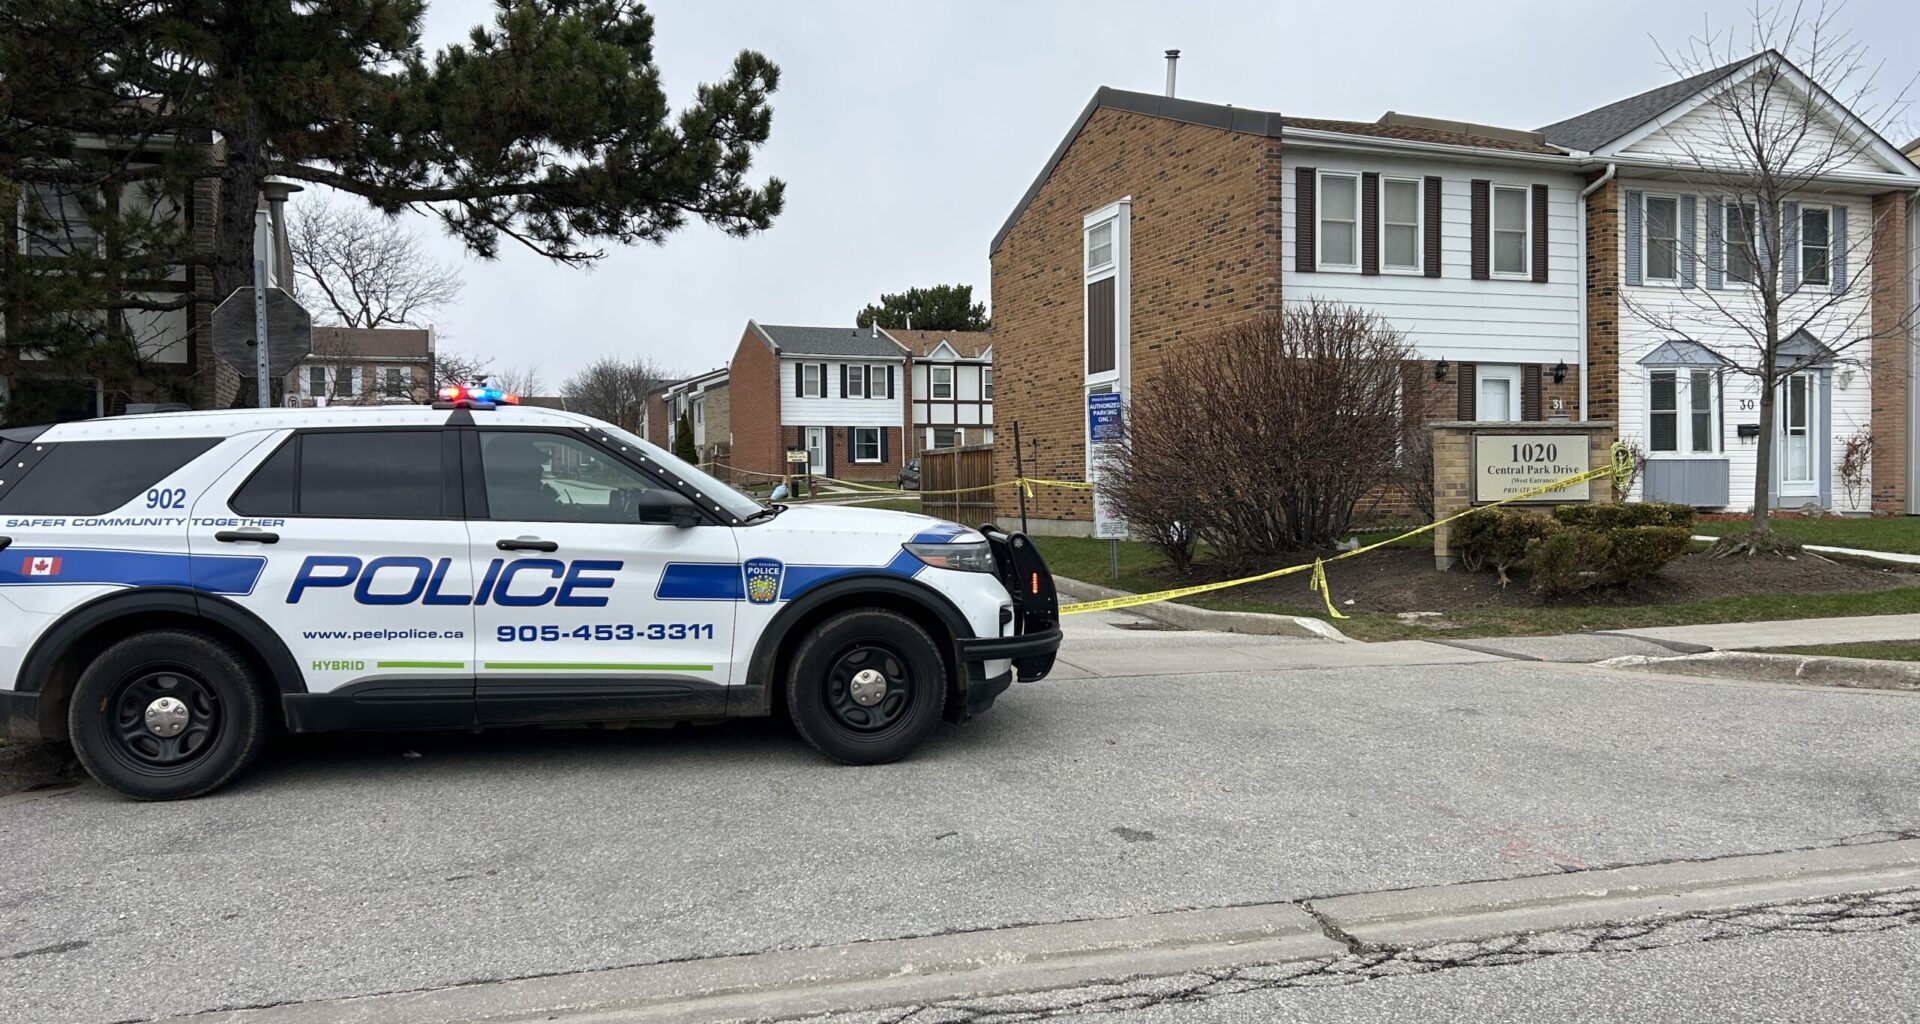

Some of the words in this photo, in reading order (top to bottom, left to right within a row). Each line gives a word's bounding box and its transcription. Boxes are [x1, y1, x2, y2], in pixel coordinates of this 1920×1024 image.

[1553, 399, 1562, 409] 31
[1740, 399, 1754, 410] 30
[1512, 443, 1557, 462] 1020
[1487, 465, 1524, 474] Central
[1527, 465, 1550, 475] Park
[1553, 465, 1579, 474] Drive
[146, 488, 187, 509] 902
[6, 518, 66, 528] SAFER
[71, 517, 188, 527] COMMUNITY
[191, 518, 285, 527] TOGETHER
[747, 567, 780, 575] POLICE
[286, 556, 624, 607] POLICE
[303, 629, 464, 641] www.peelpolice.ca
[497, 624, 714, 642] 905-453-3311
[312, 661, 365, 671] HYBRID
